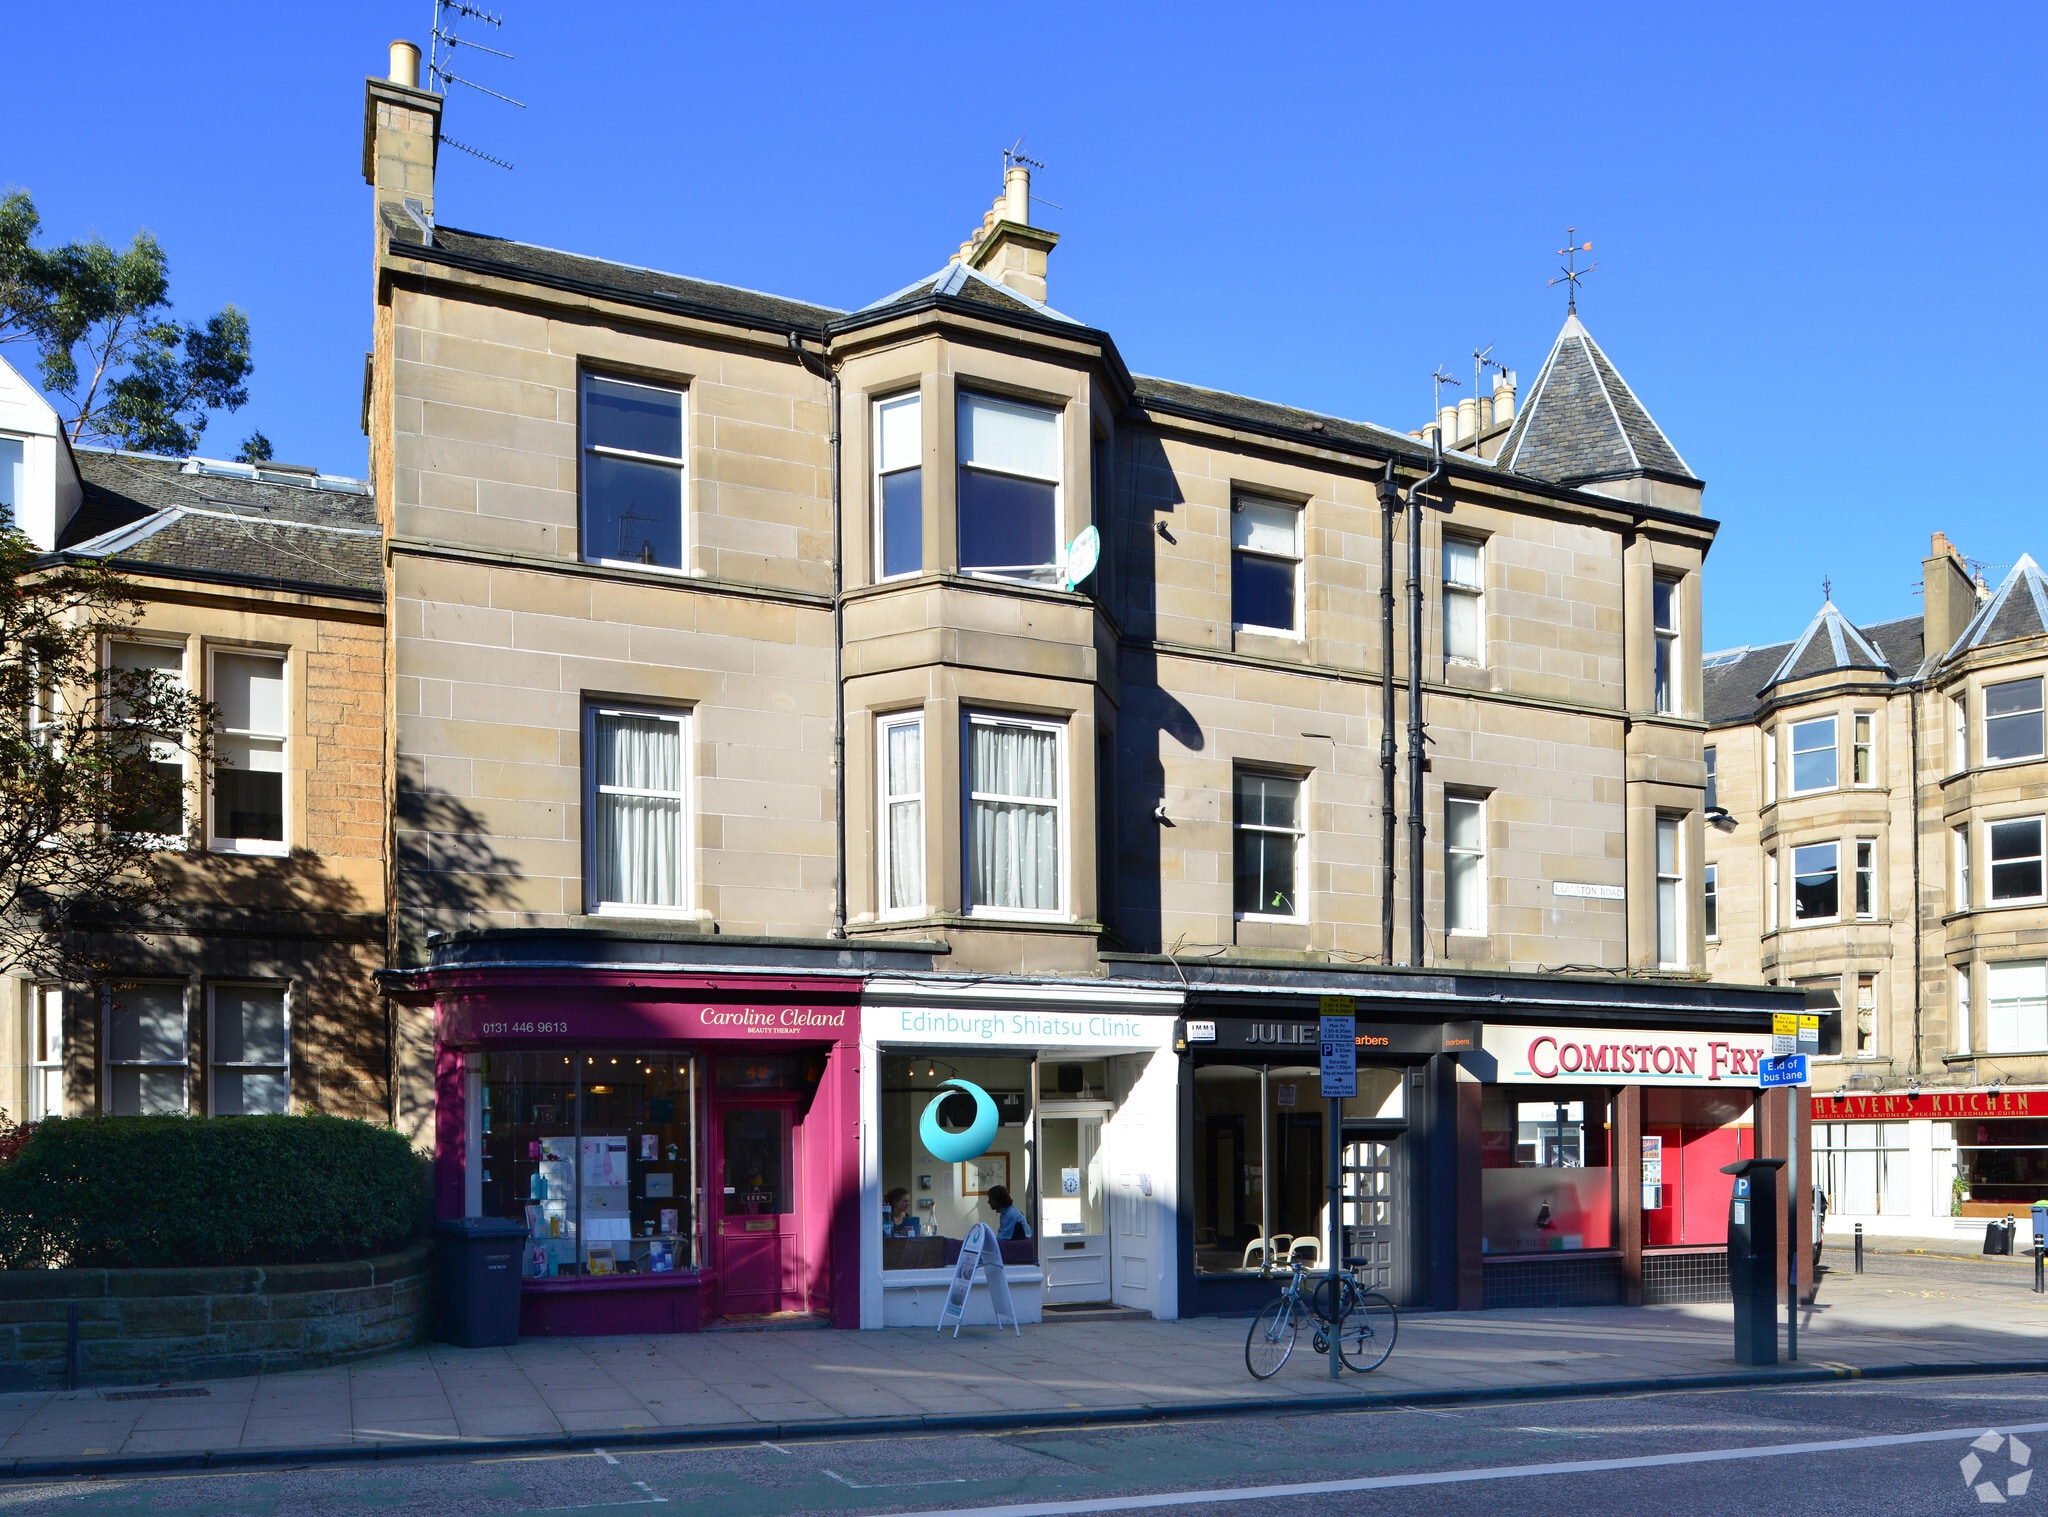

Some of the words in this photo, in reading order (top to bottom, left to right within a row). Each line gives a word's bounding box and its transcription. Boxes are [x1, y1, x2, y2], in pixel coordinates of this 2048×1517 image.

[1555, 884, 1597, 895] COMSTON
[1600, 887, 1623, 897] ROAD
[700, 1007, 776, 1025] Caroline
[780, 1008, 846, 1026] Cleland
[483, 1022, 508, 1034] 0131
[512, 1022, 534, 1034] 446
[537, 1022, 568, 1033] 9613
[901, 1011, 1005, 1039] Edinburgh
[1012, 1014, 1082, 1036] Shiatsu
[1089, 1017, 1141, 1037] Clinic
[1246, 1023, 1320, 1044] JULIE'
[1354, 1034, 1389, 1046] arbers
[1445, 1038, 1470, 1046] barbers
[1527, 1035, 1696, 1078] COMISTON
[1707, 1041, 1764, 1080] FRY
[1787, 1059, 1798, 1069] of
[1763, 1073, 1780, 1082] bus
[1782, 1071, 1803, 1080] lane
[1815, 1096, 1914, 1114] HEAVEN'S
[1932, 1093, 2028, 1112] KITCHEN
[1738, 1178, 1748, 1196] P
